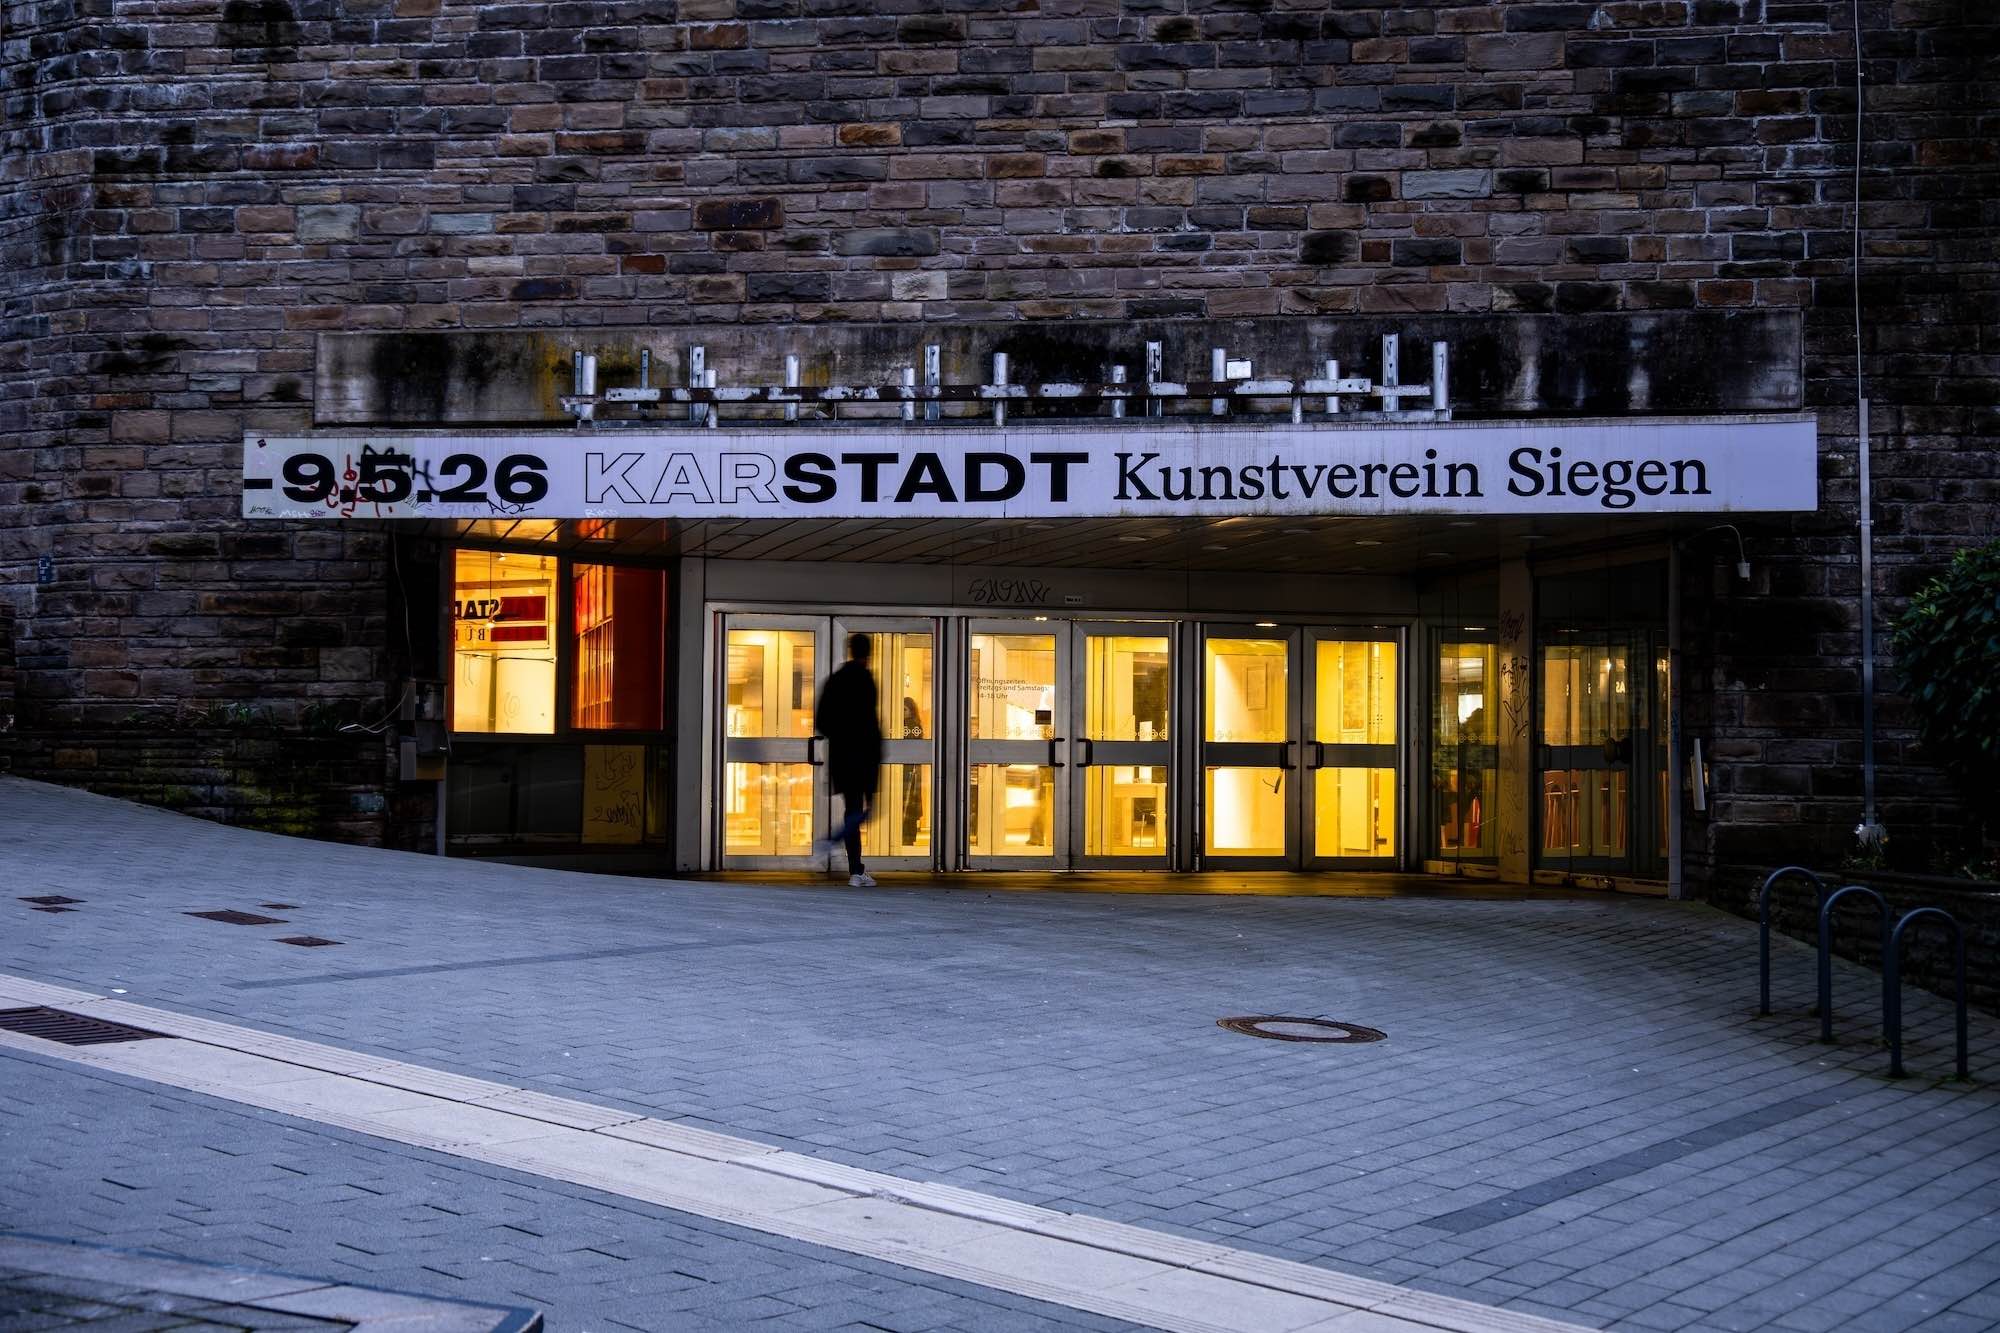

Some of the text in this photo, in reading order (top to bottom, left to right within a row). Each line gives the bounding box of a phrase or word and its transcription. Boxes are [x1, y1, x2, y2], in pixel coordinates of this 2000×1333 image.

[585, 453, 1088, 504] KARSTADT
[1114, 448, 1484, 501] Kunstverein
[1507, 447, 1711, 508] Siegen
